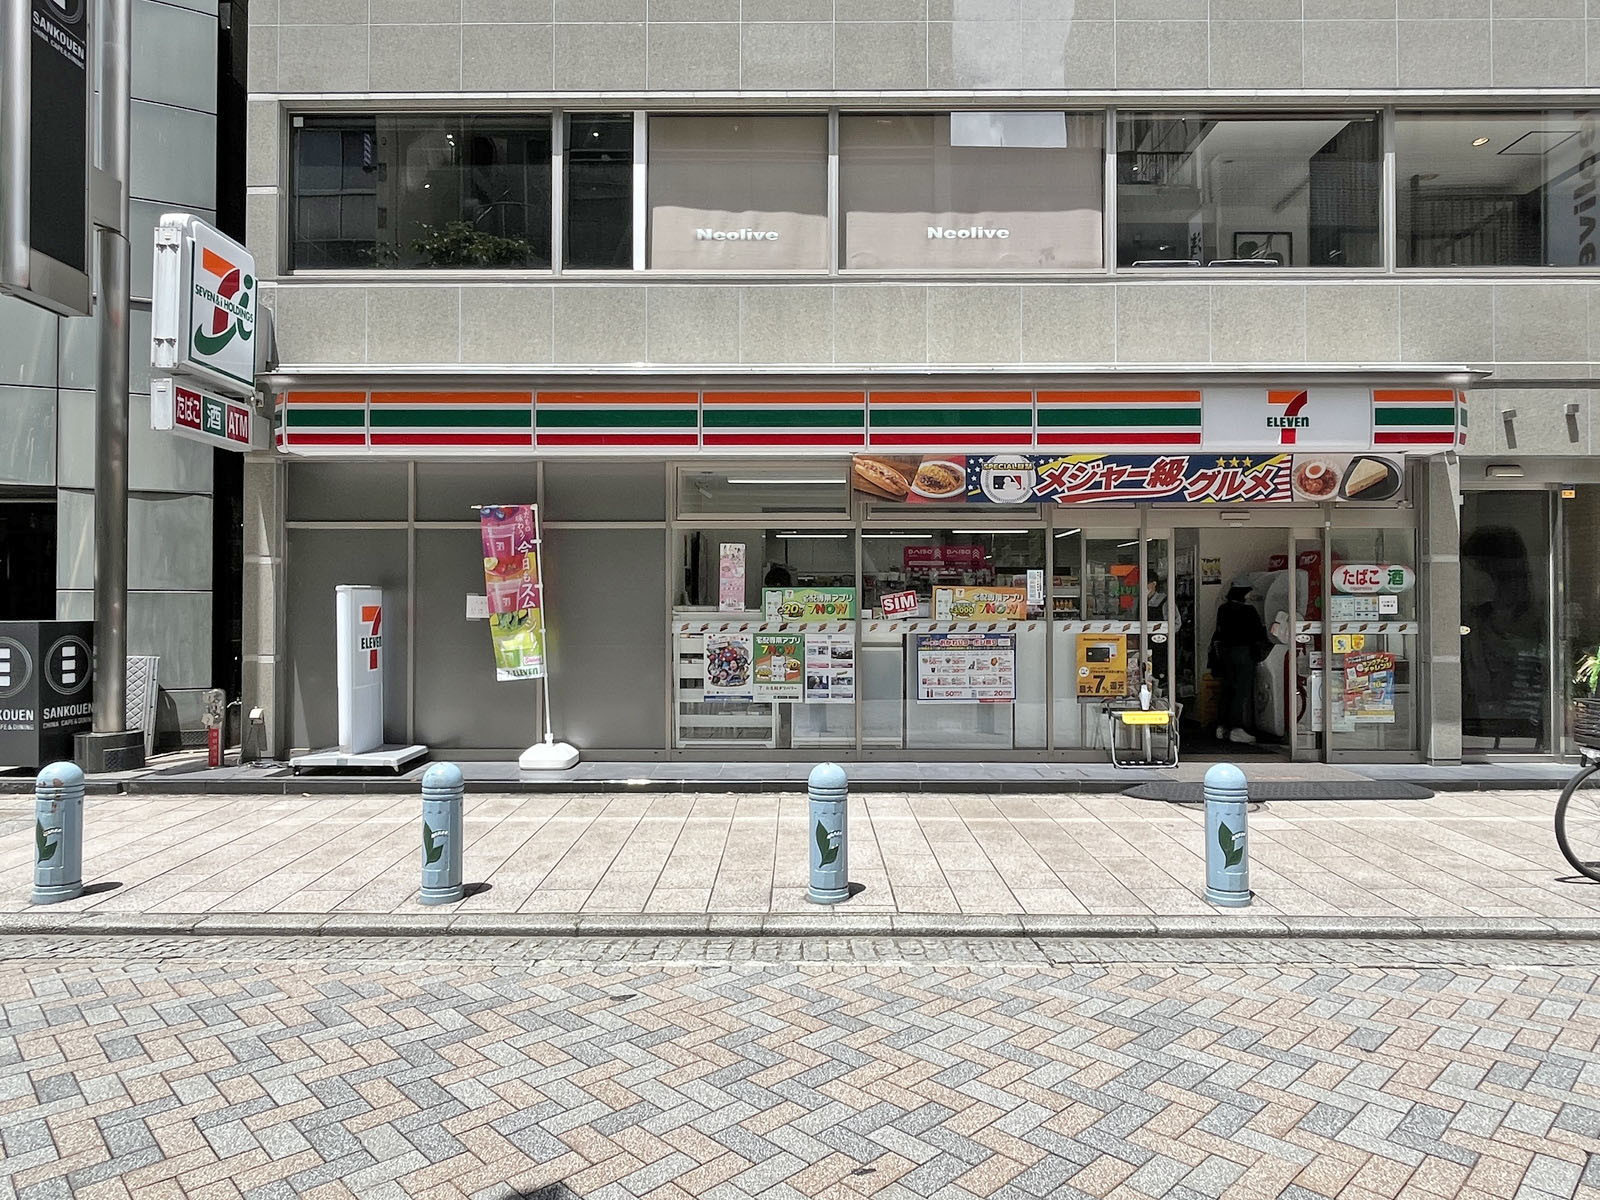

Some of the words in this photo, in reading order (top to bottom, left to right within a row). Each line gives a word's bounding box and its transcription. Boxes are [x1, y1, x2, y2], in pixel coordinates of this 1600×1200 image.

[32, 10, 84, 60] SANKOUEN
[696, 228, 779, 241] Neolive
[927, 226, 1010, 240] Neolive
[223, 299, 254, 323] HOLDINGS
[176, 393, 201, 424] たばこ
[206, 403, 222, 431] 酒
[228, 409, 248, 438] ATM
[1343, 568, 1380, 586] たばこ
[1387, 569, 1404, 586] 酒
[808, 603, 848, 615] 7NOW
[883, 594, 915, 612] SIM
